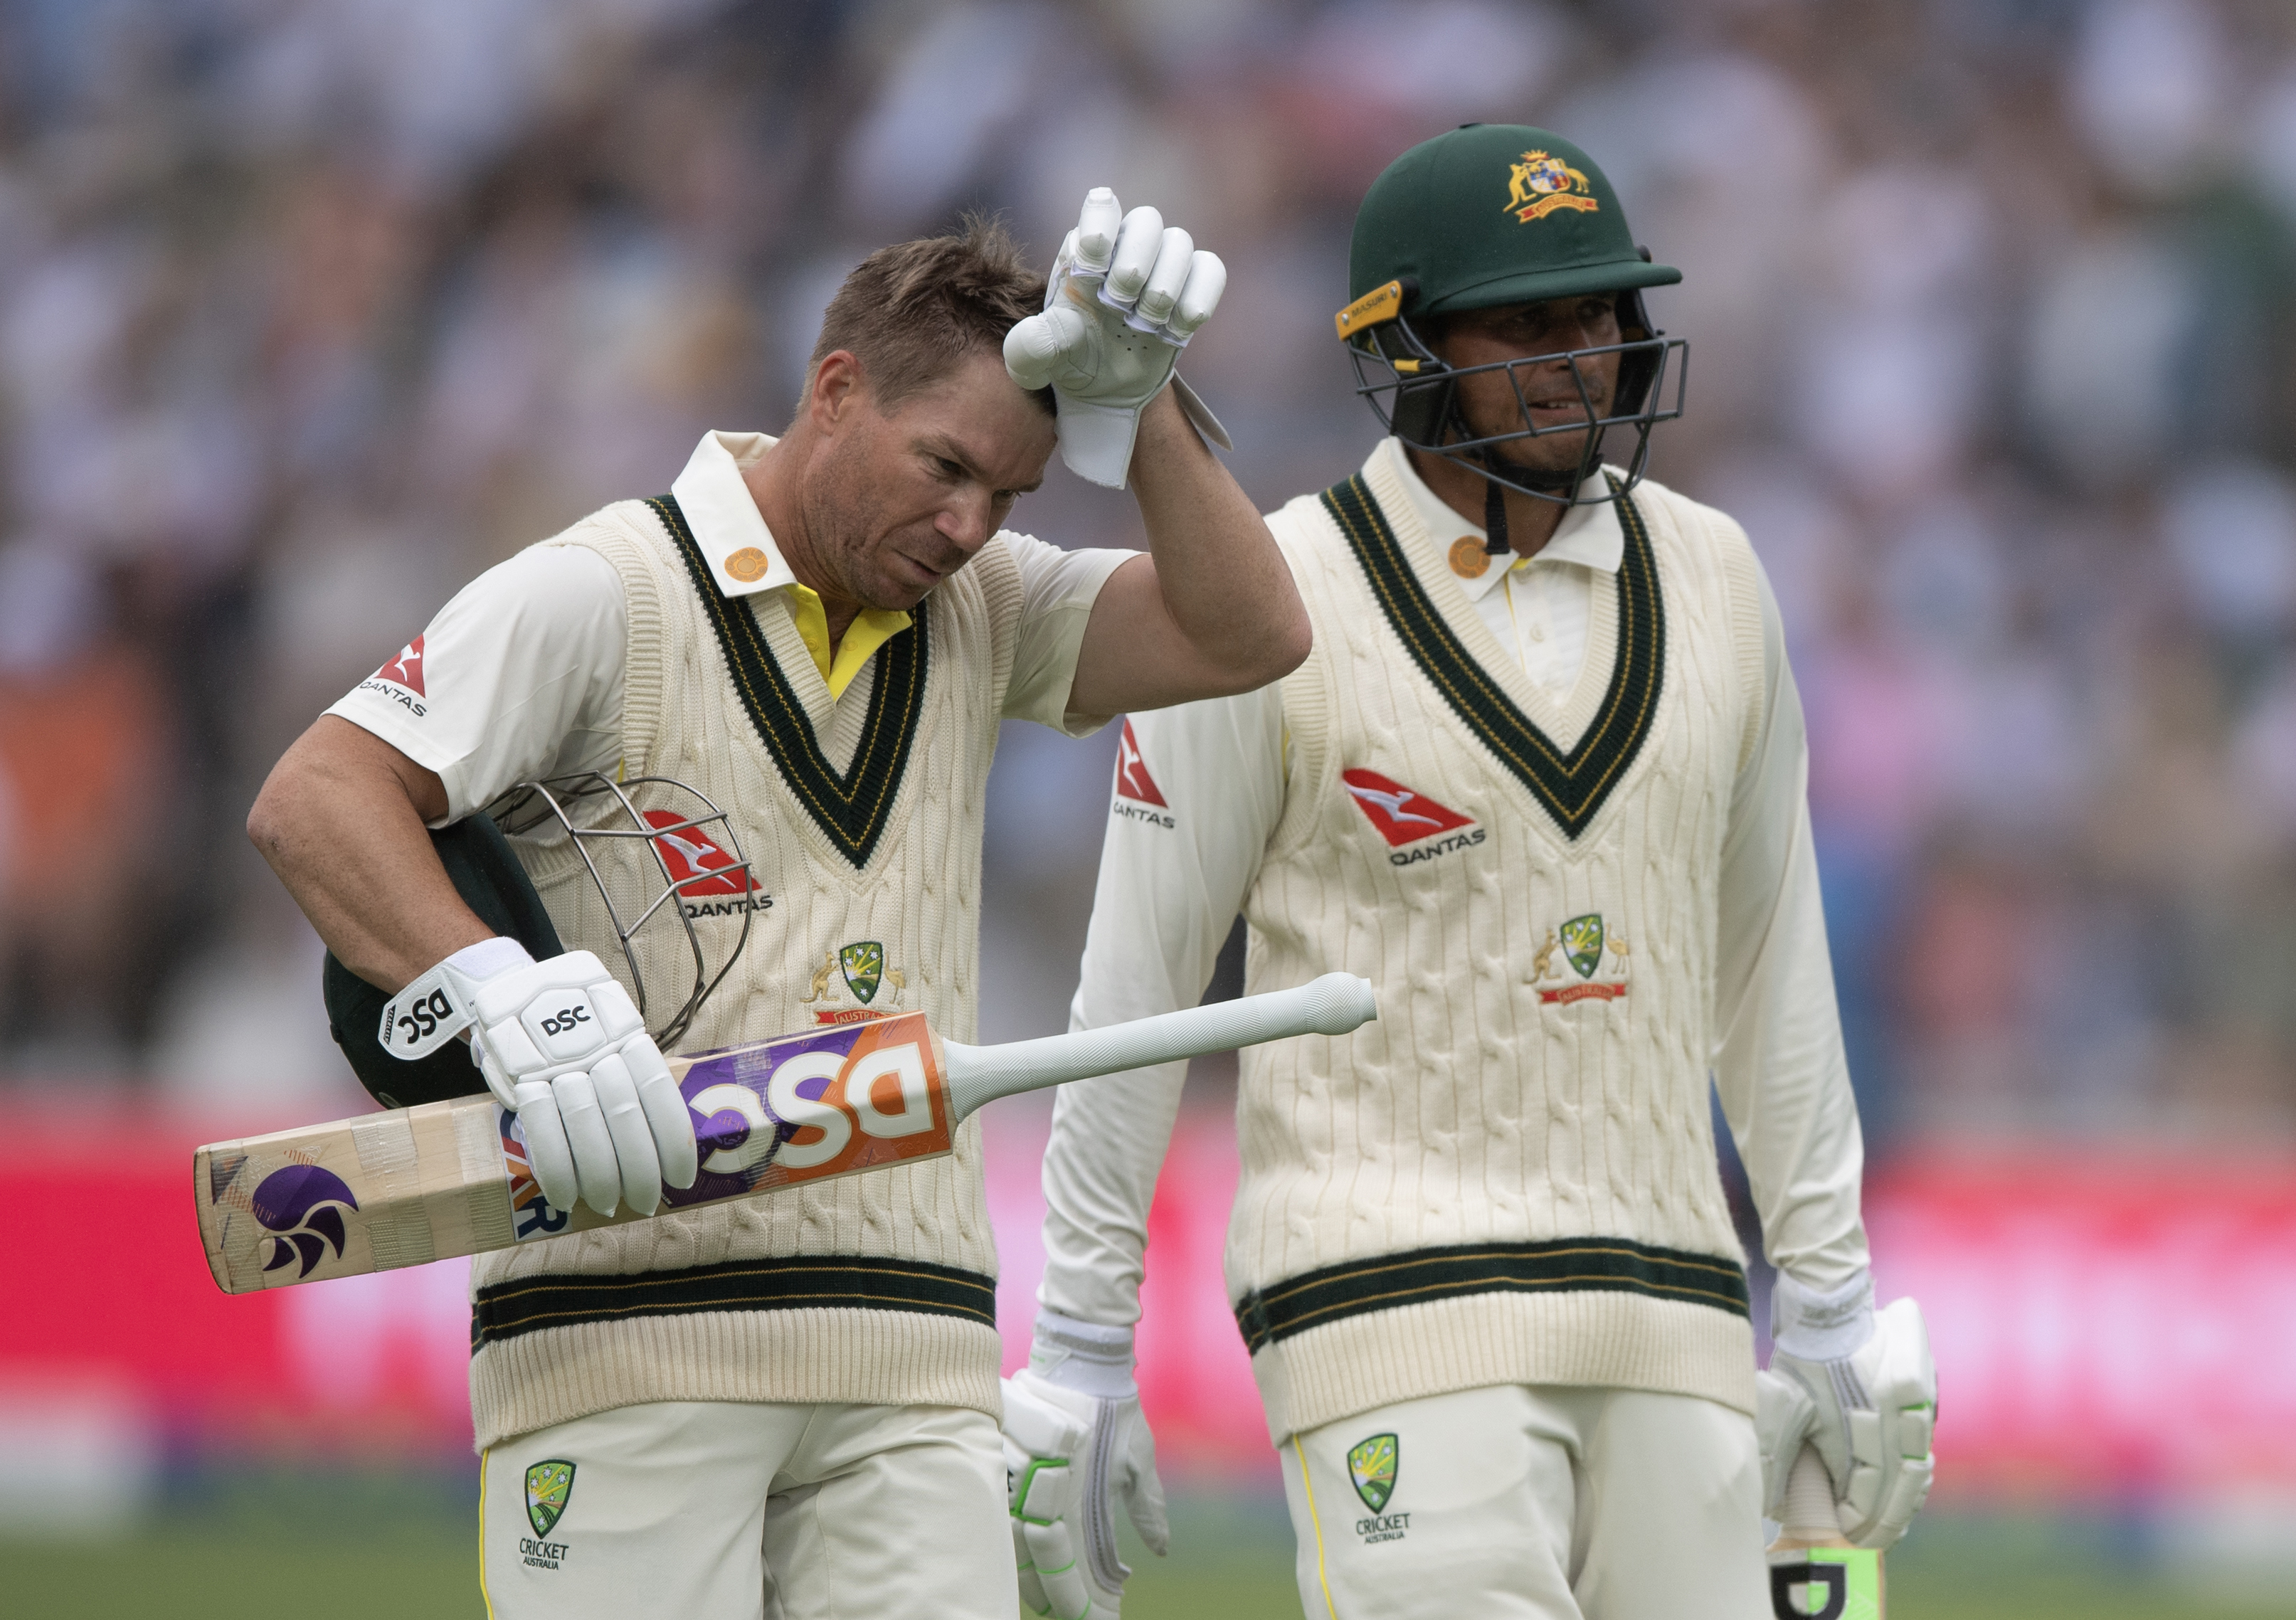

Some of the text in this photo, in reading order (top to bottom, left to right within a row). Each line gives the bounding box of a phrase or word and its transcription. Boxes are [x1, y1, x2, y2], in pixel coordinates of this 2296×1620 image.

[1352, 292, 1387, 318] MASURI
[359, 681, 427, 717] QANTAS
[1390, 828, 1486, 866] QANTAS
[398, 987, 454, 1044] DSC
[541, 1005, 591, 1037] DSC
[840, 1011, 881, 1025] AUSTRA
[688, 1042, 935, 1174] DSC
[1355, 1513, 1411, 1535] CRICKET
[519, 1537, 569, 1560] CRICKET
[1364, 1530, 1405, 1545] AUSTRALIA
[523, 1556, 559, 1570] AUSTRALIA
